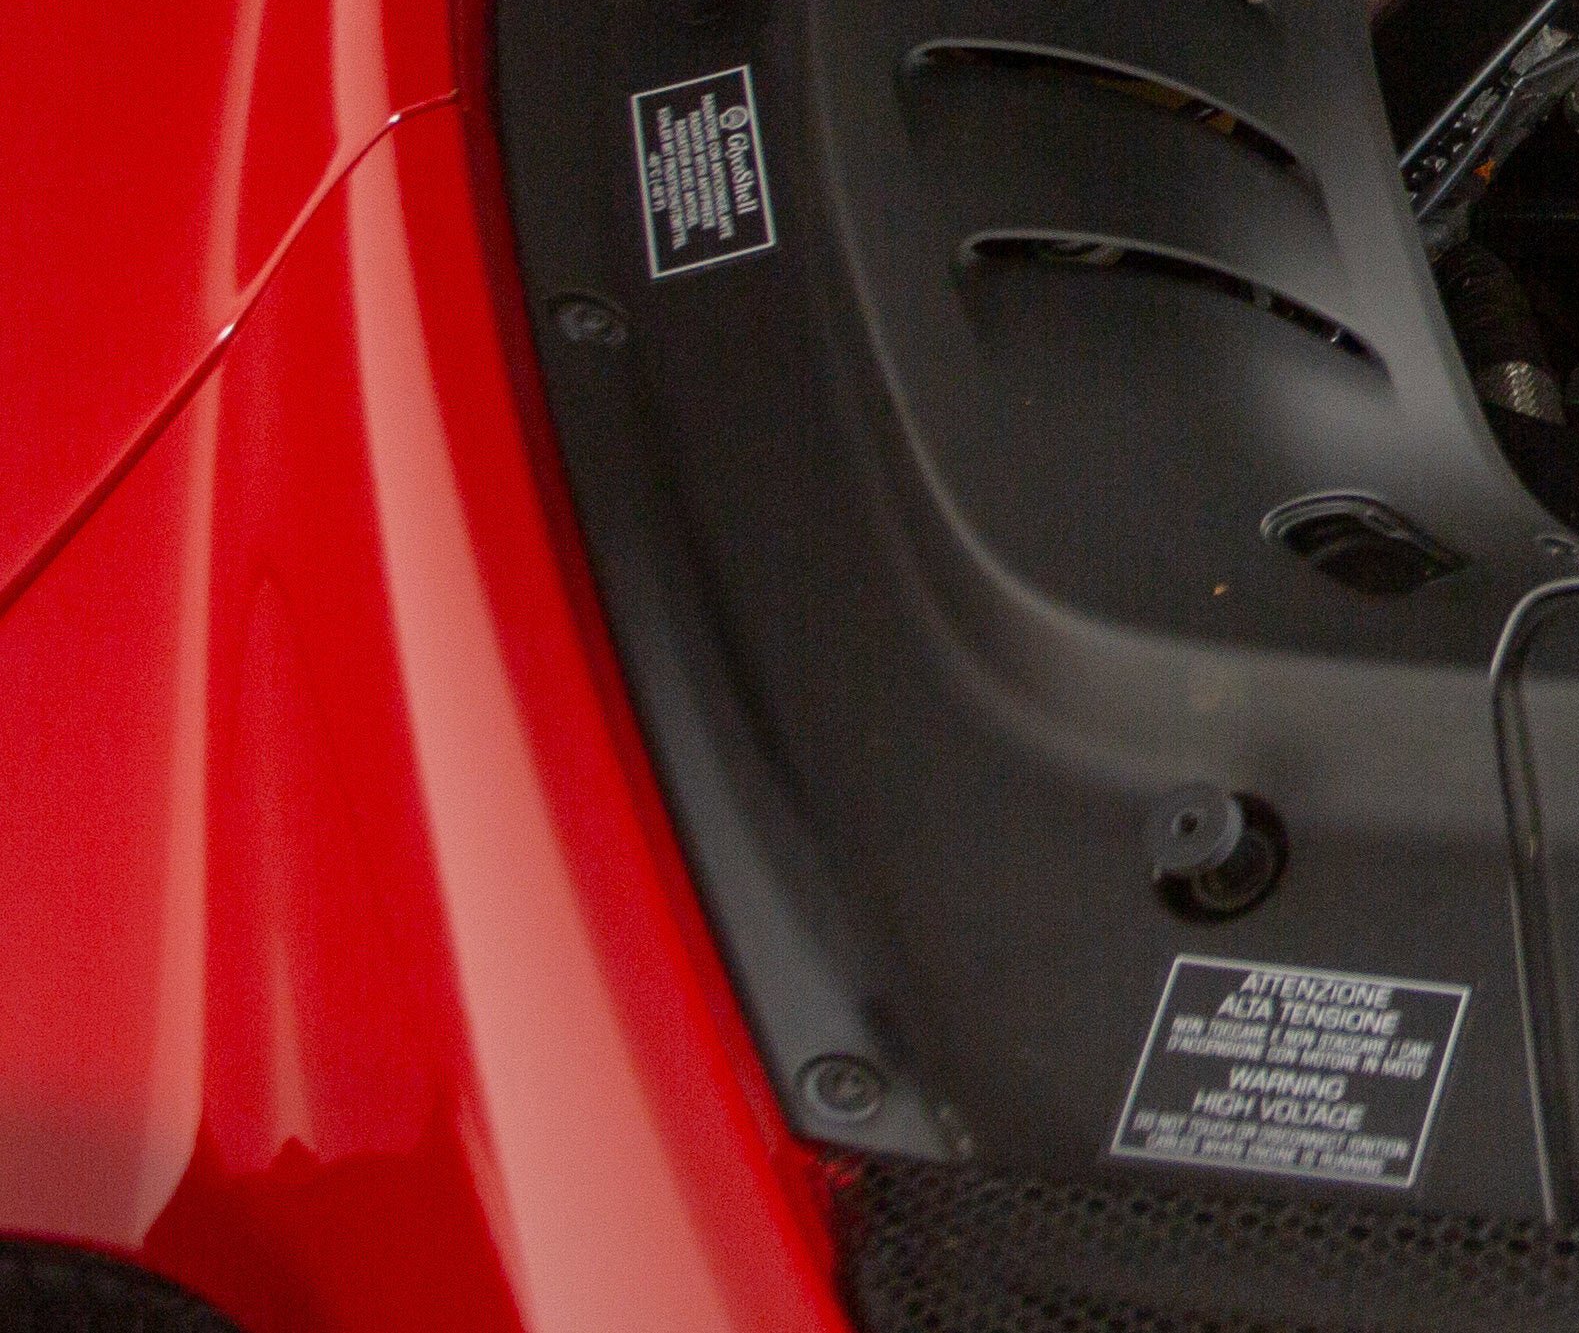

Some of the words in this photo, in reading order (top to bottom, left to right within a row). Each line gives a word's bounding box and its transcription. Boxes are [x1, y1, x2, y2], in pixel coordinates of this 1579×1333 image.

[687, 109, 706, 154] RADIATOR
[700, 92, 720, 141] RADIATORE
[723, 130, 759, 216] GlycoShell
[1238, 970, 1393, 1009] ATTENZIONE
[1215, 992, 1277, 1022] ALTA
[1274, 999, 1400, 1036] TENSIONE
[1205, 1018, 1269, 1043] TOCCARE
[1315, 1031, 1389, 1057] STACCARE
[1225, 1064, 1349, 1101] WARNING
[1263, 1044, 1298, 1065] CON
[1297, 1048, 1359, 1072] MOTORE
[1359, 1056, 1380, 1075] IN
[1378, 1058, 1425, 1080] MOTO
[1190, 1086, 1257, 1118] HIGH
[1254, 1094, 1367, 1131] VOLTAGE
